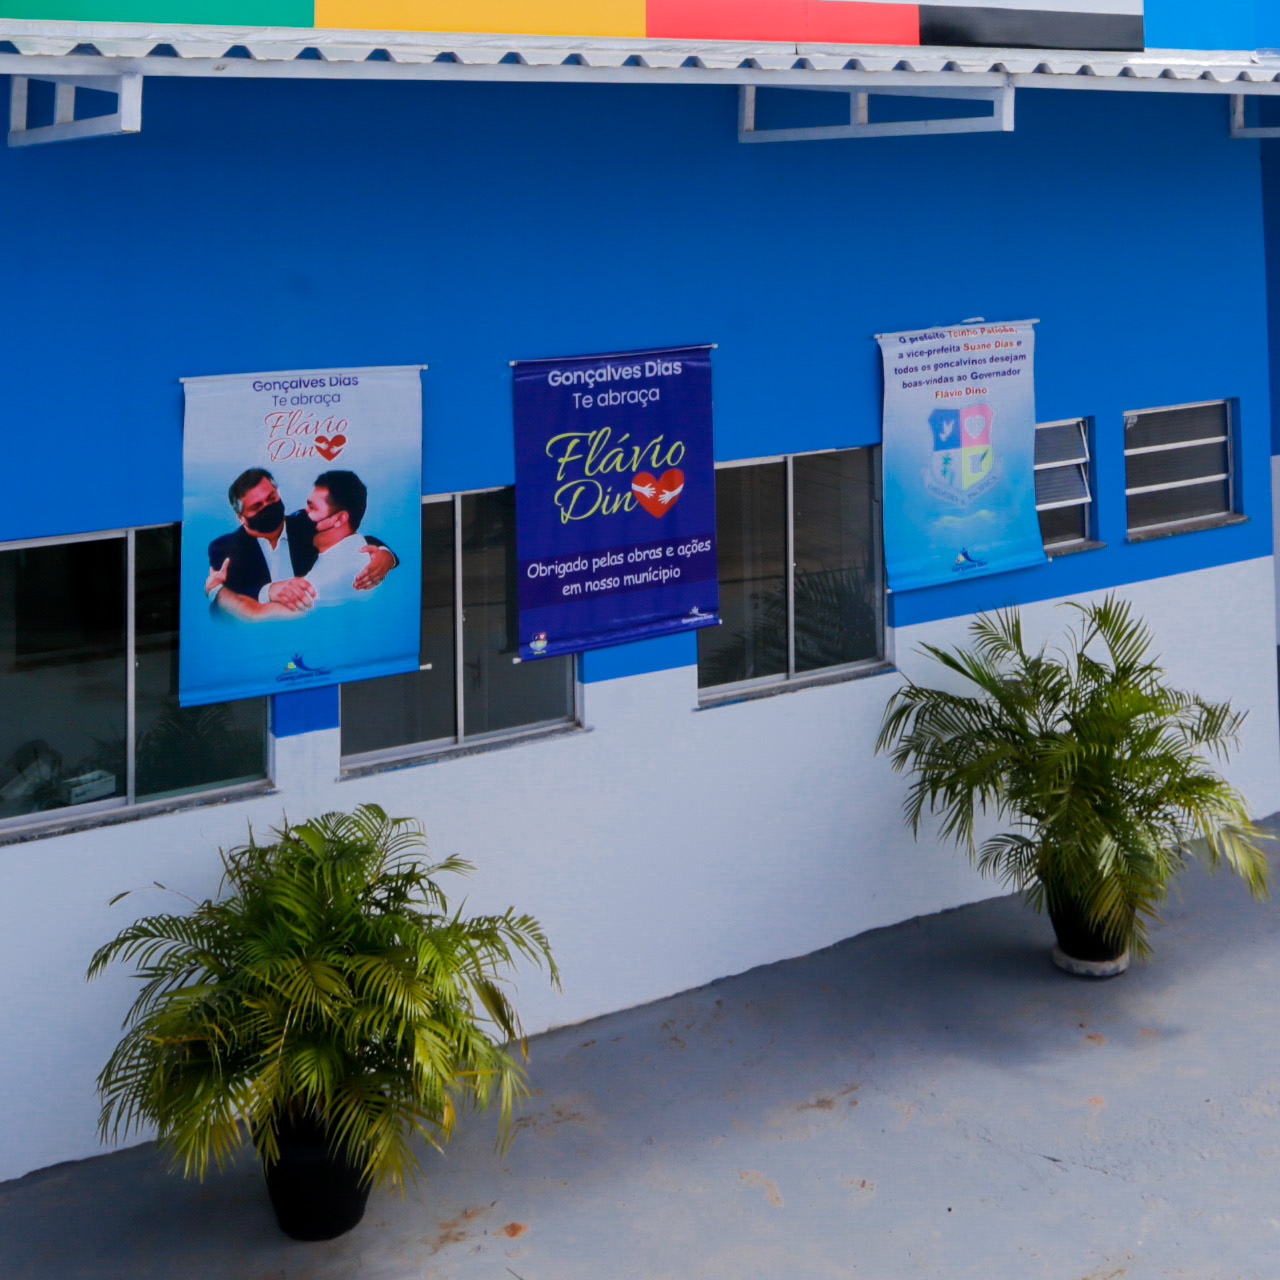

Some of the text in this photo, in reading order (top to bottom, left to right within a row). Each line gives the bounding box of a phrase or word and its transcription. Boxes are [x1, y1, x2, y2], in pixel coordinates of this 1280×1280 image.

[898, 335, 907, 344] O
[909, 332, 945, 344] prefeito
[898, 352, 904, 360] a
[906, 345, 961, 358] vice-prefeita
[994, 340, 1014, 349] Dias
[547, 359, 682, 388] Gonçalves Dias
[894, 365, 919, 376] todos
[921, 364, 932, 372] os
[989, 354, 1027, 364] desejam
[252, 374, 359, 394] Gonçalves Dias
[902, 368, 1021, 390] boas-vindas ao Governador
[272, 393, 341, 408] Te abraça
[573, 386, 660, 409] Te abraça
[965, 387, 988, 396] Dino
[264, 409, 348, 438] Flávio
[545, 426, 685, 481] Flávio
[526, 539, 712, 579] Obrigado pelas obras e ações
[562, 566, 681, 596] em nosso munícipio
